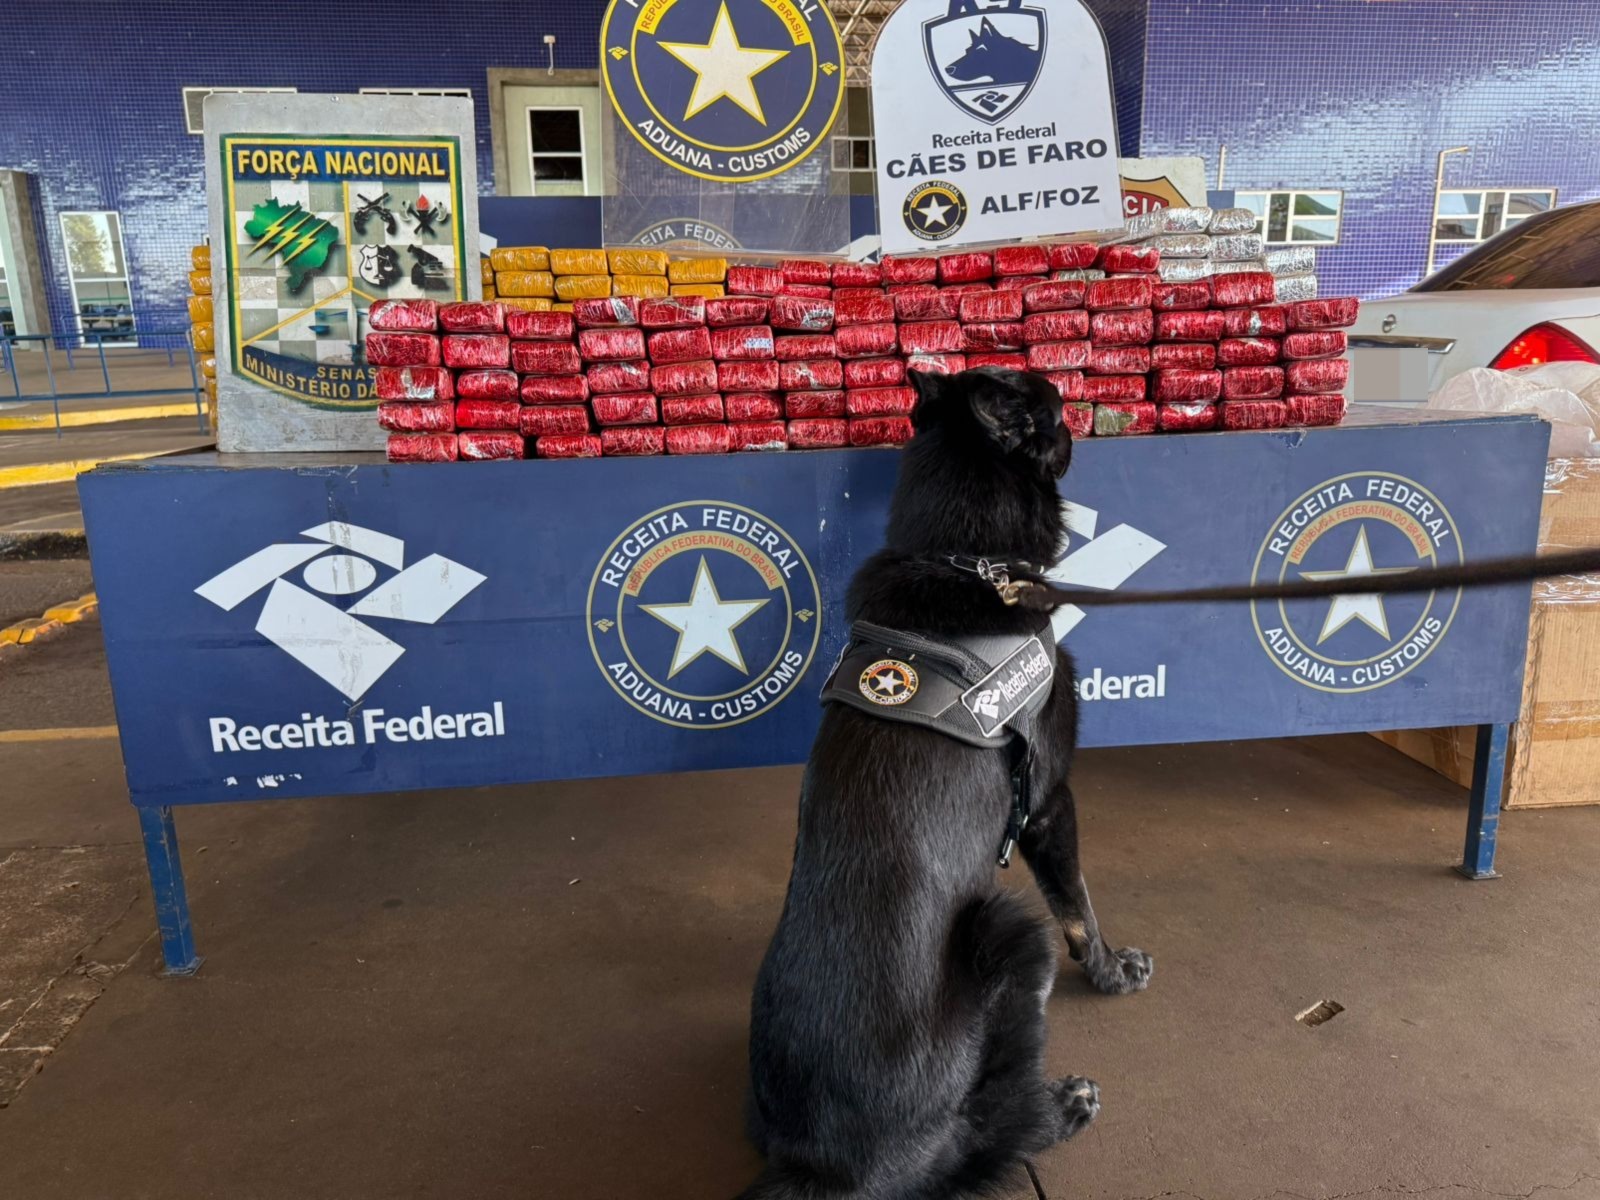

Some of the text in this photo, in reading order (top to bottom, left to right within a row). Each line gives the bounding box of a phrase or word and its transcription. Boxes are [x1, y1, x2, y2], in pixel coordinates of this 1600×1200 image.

[777, 2, 805, 41] BRASIL
[638, 119, 712, 170] ADUANA
[728, 127, 811, 173] CUSTOMS
[886, 139, 1108, 178] CÃES DE FARO
[932, 123, 1056, 149] Receita Federal
[237, 150, 446, 179] FORÇA NACIONAL
[981, 185, 1100, 214] ALF/FOZ
[640, 223, 735, 249] EITA FEDER
[246, 353, 350, 399] MINISTÉRIO
[316, 366, 377, 380] SENAS
[1268, 479, 1451, 556] RECEITA FEDERAL
[1336, 505, 1393, 520] FEDERATIVA
[1394, 513, 1406, 526] DO
[1406, 523, 1430, 554] BRASIL
[601, 508, 799, 587] RECEITA FEDERAL
[672, 535, 735, 550] FEDERATIVA
[736, 543, 752, 556] DO
[750, 553, 779, 586] BRASIL
[997, 645, 1050, 703] Receita Federal
[1264, 627, 1336, 685] ADUANA
[1352, 617, 1442, 685] CUSTOMS
[608, 661, 693, 720] ADUANA
[710, 650, 803, 721] CUSTOMS
[1074, 664, 1166, 701] deral
[209, 701, 505, 753] Receita Federal
